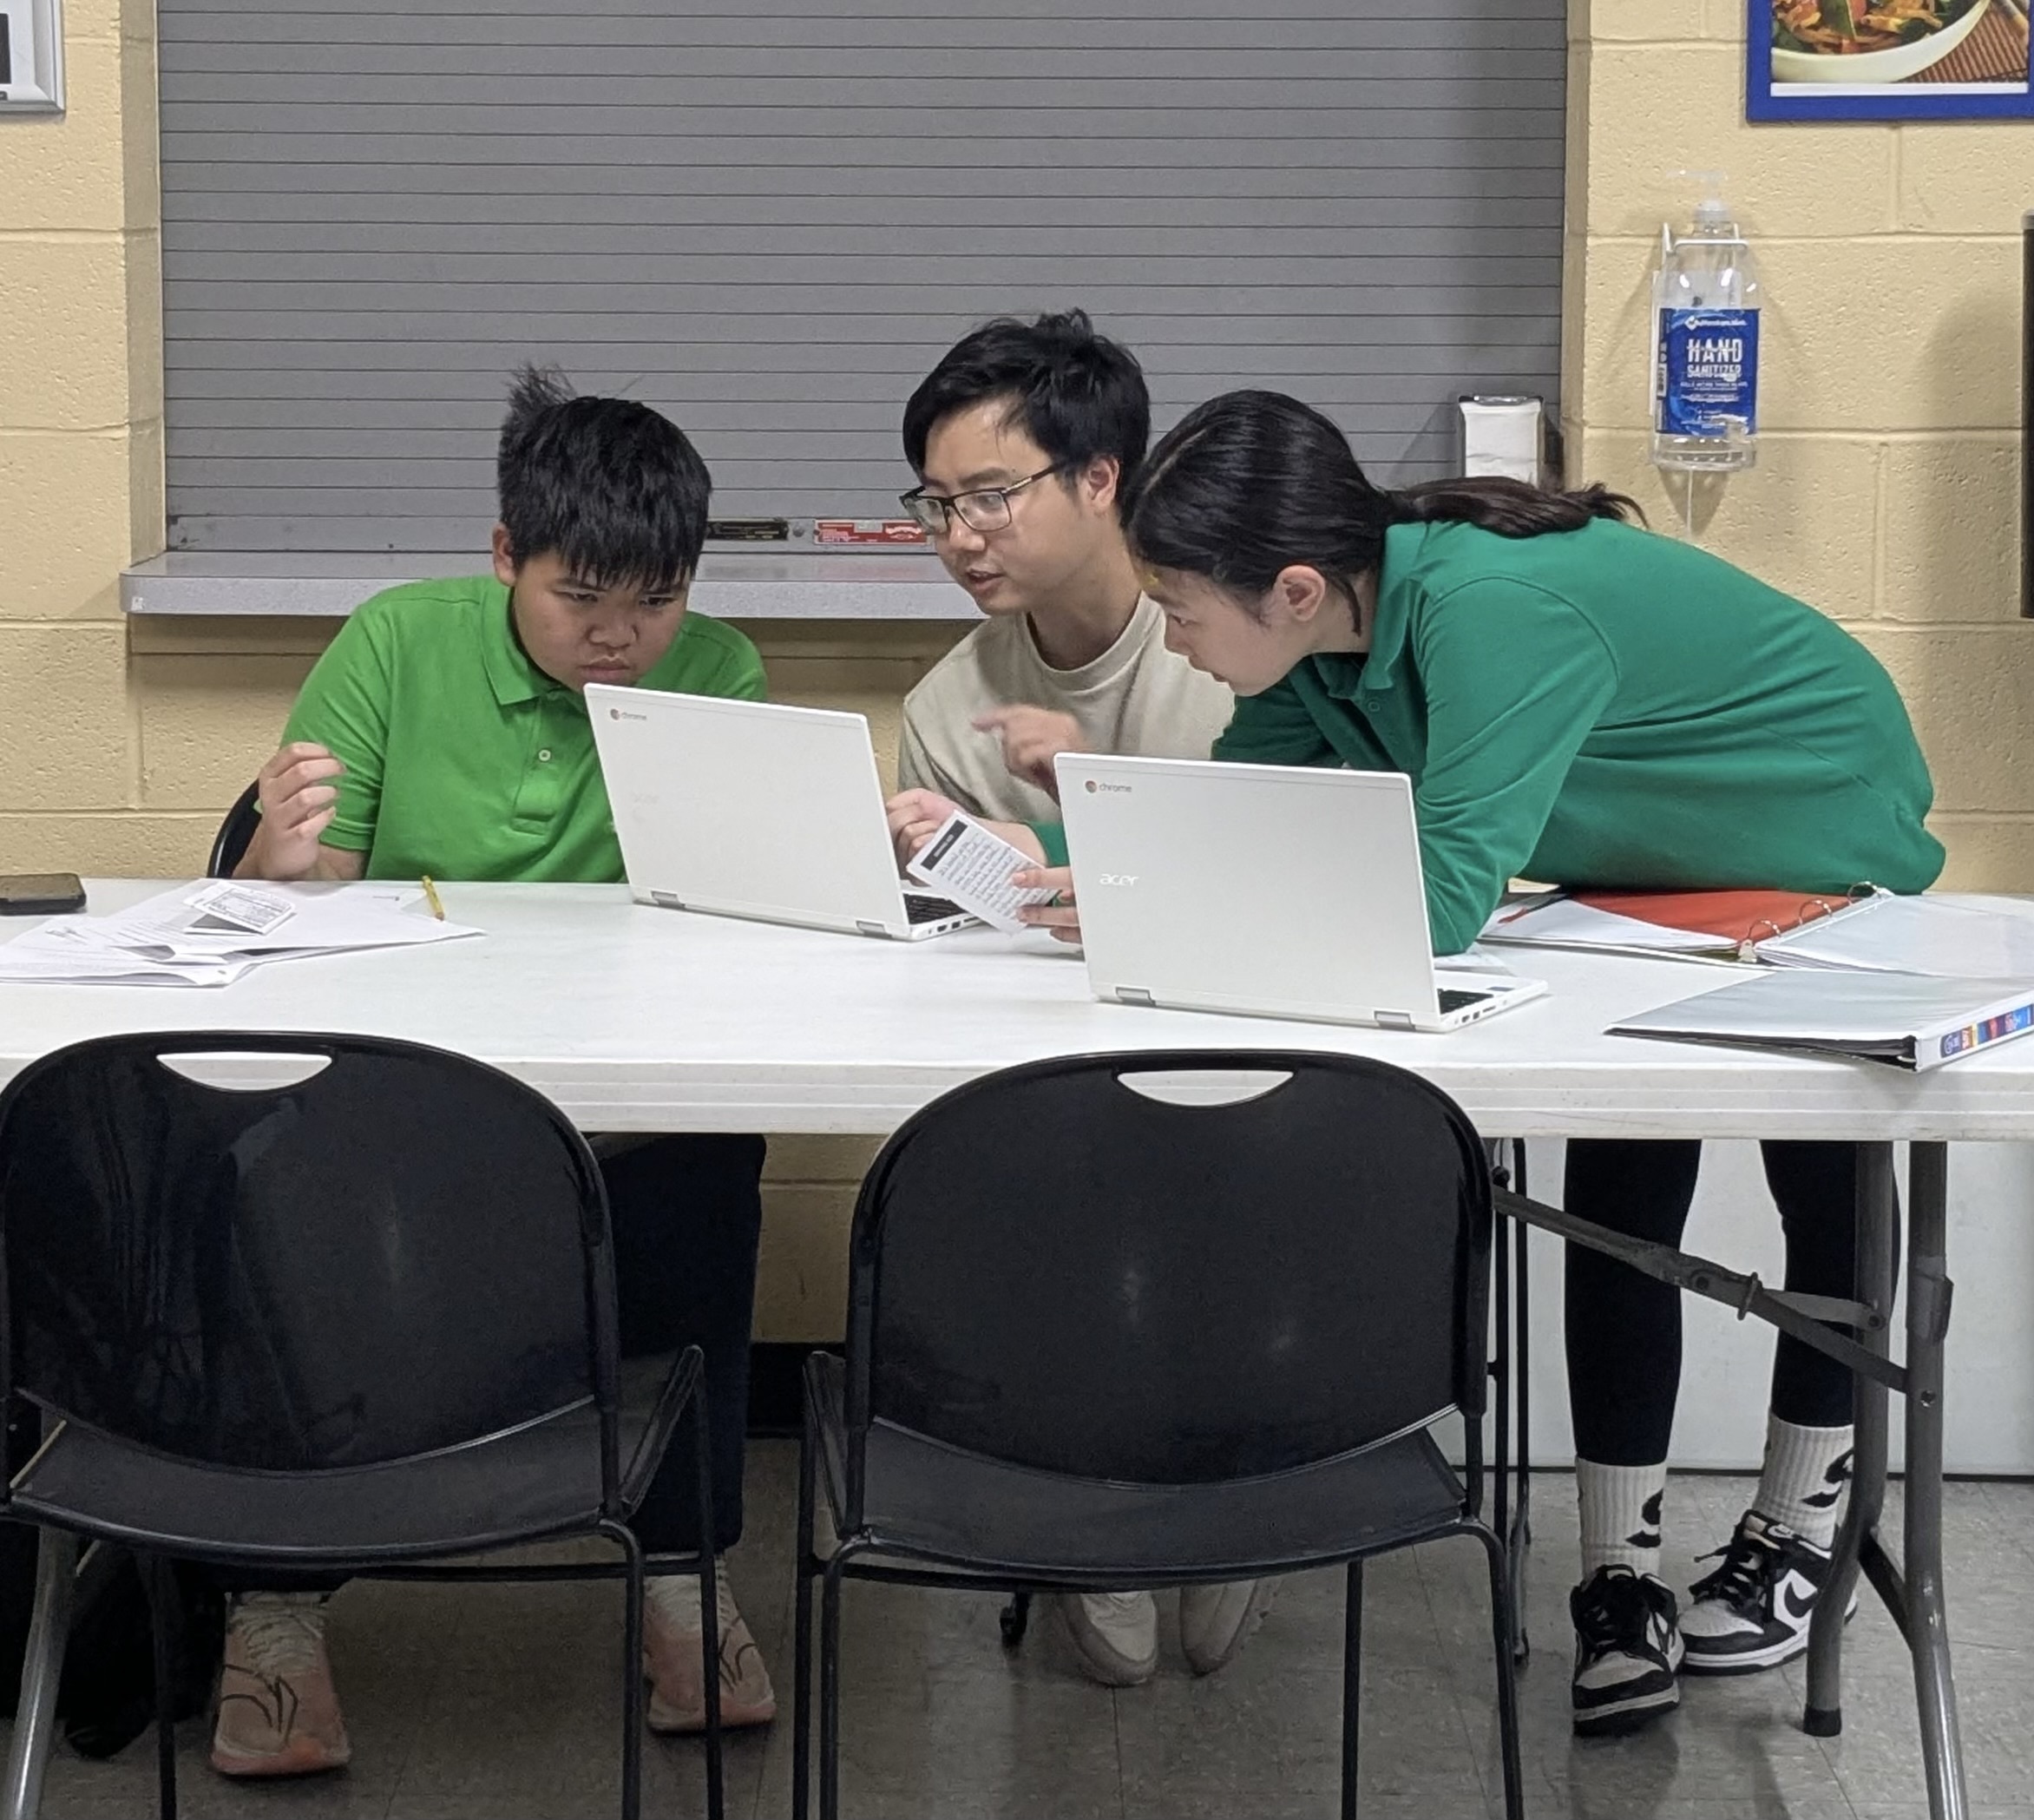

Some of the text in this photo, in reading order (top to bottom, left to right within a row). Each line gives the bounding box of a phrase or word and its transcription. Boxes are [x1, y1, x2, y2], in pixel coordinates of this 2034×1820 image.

[1688, 338, 1742, 362] HAND
[1687, 365, 1742, 378] SANITIZER
[1099, 783, 1132, 792] chrome
[1099, 873, 1138, 885] acer
